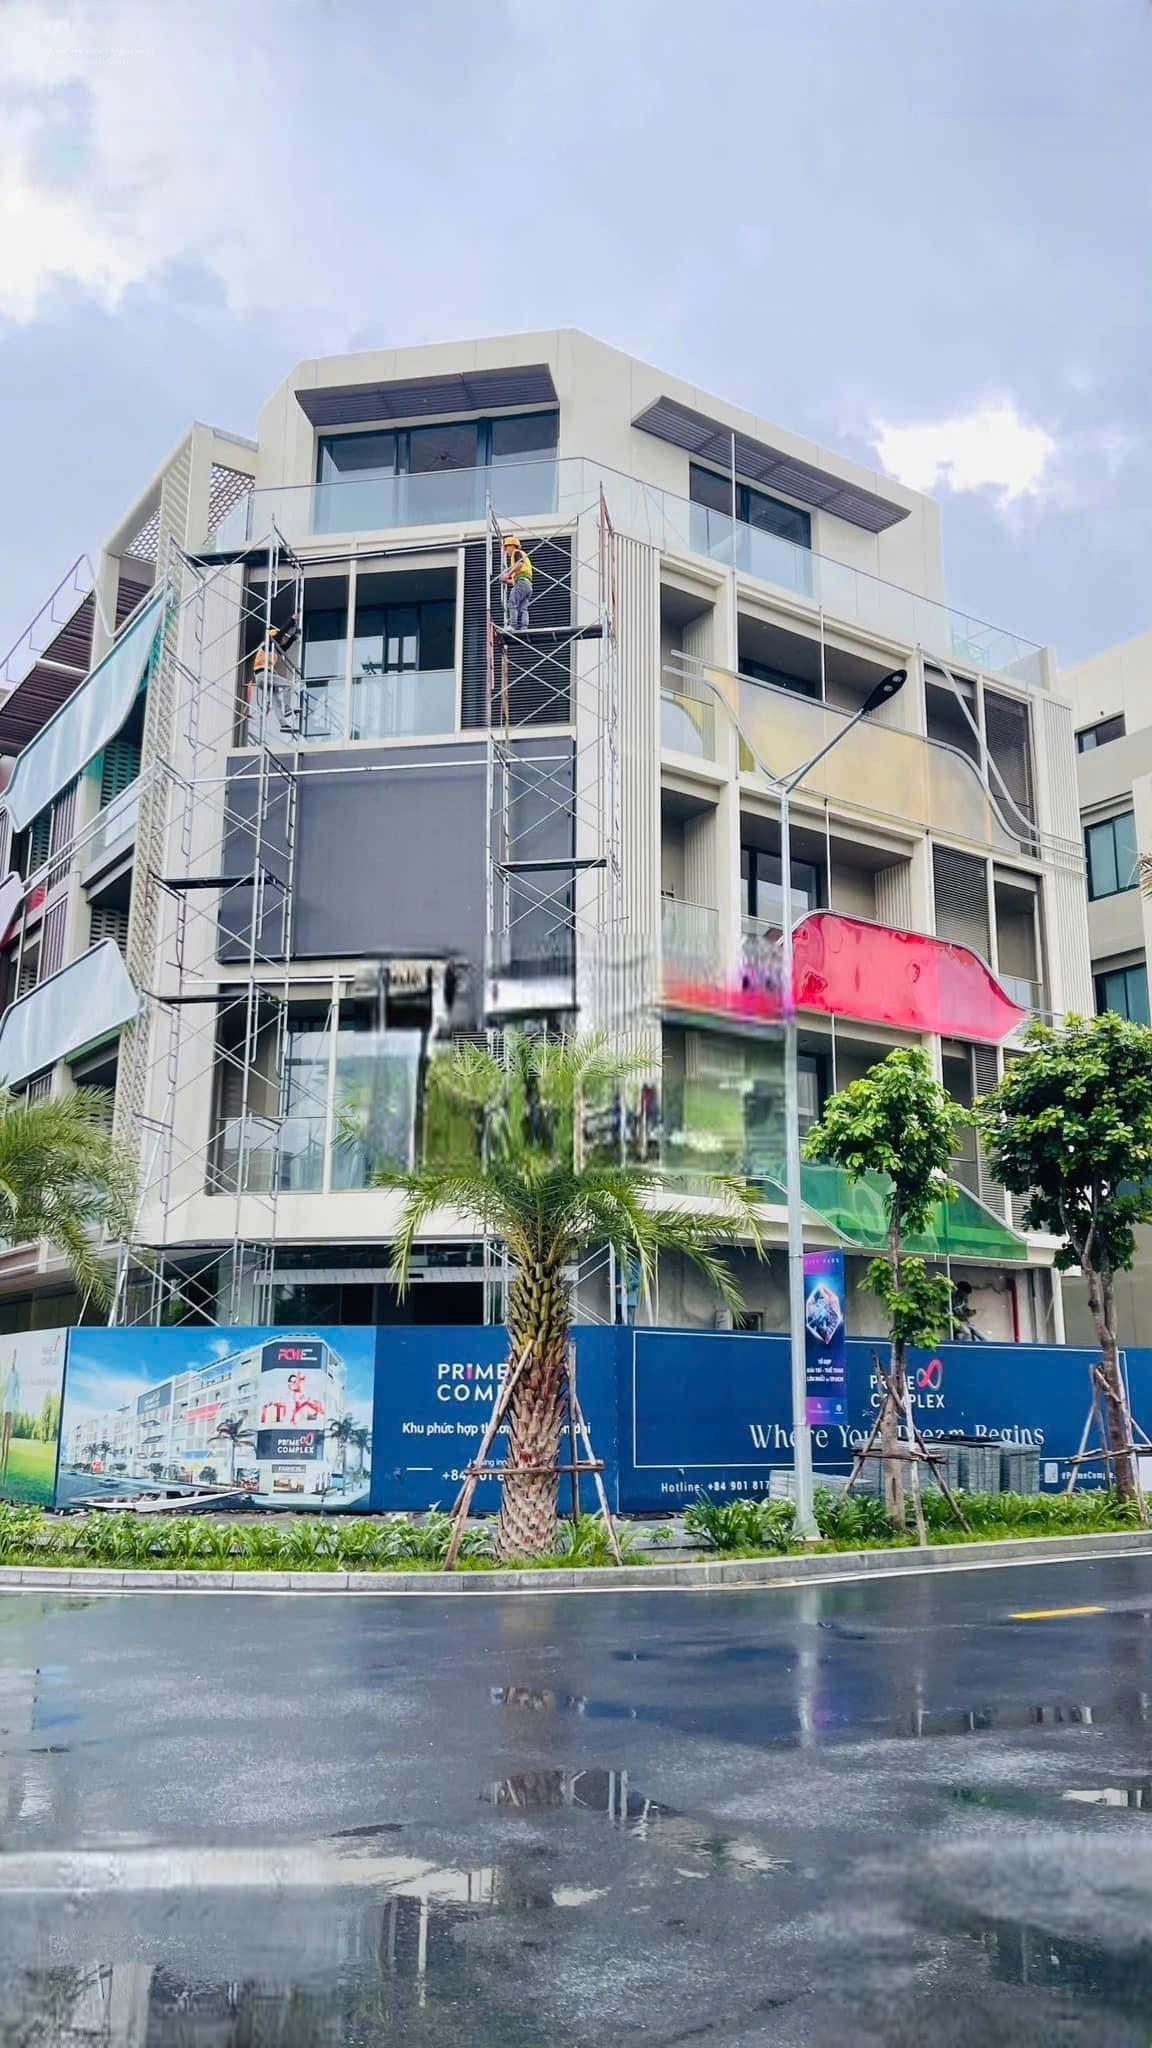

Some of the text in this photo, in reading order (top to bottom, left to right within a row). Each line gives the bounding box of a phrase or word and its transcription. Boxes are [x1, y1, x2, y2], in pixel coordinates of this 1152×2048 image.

[437, 1363, 510, 1380] PRIME
[870, 1392, 945, 1409] CPLEX
[402, 1422, 425, 1434] Khu
[426, 1422, 455, 1437] phức
[456, 1422, 479, 1437] hợp
[276, 1446, 315, 1455] COMPLEX
[707, 1481, 727, 1491] +84
[730, 1480, 748, 1491] 901
